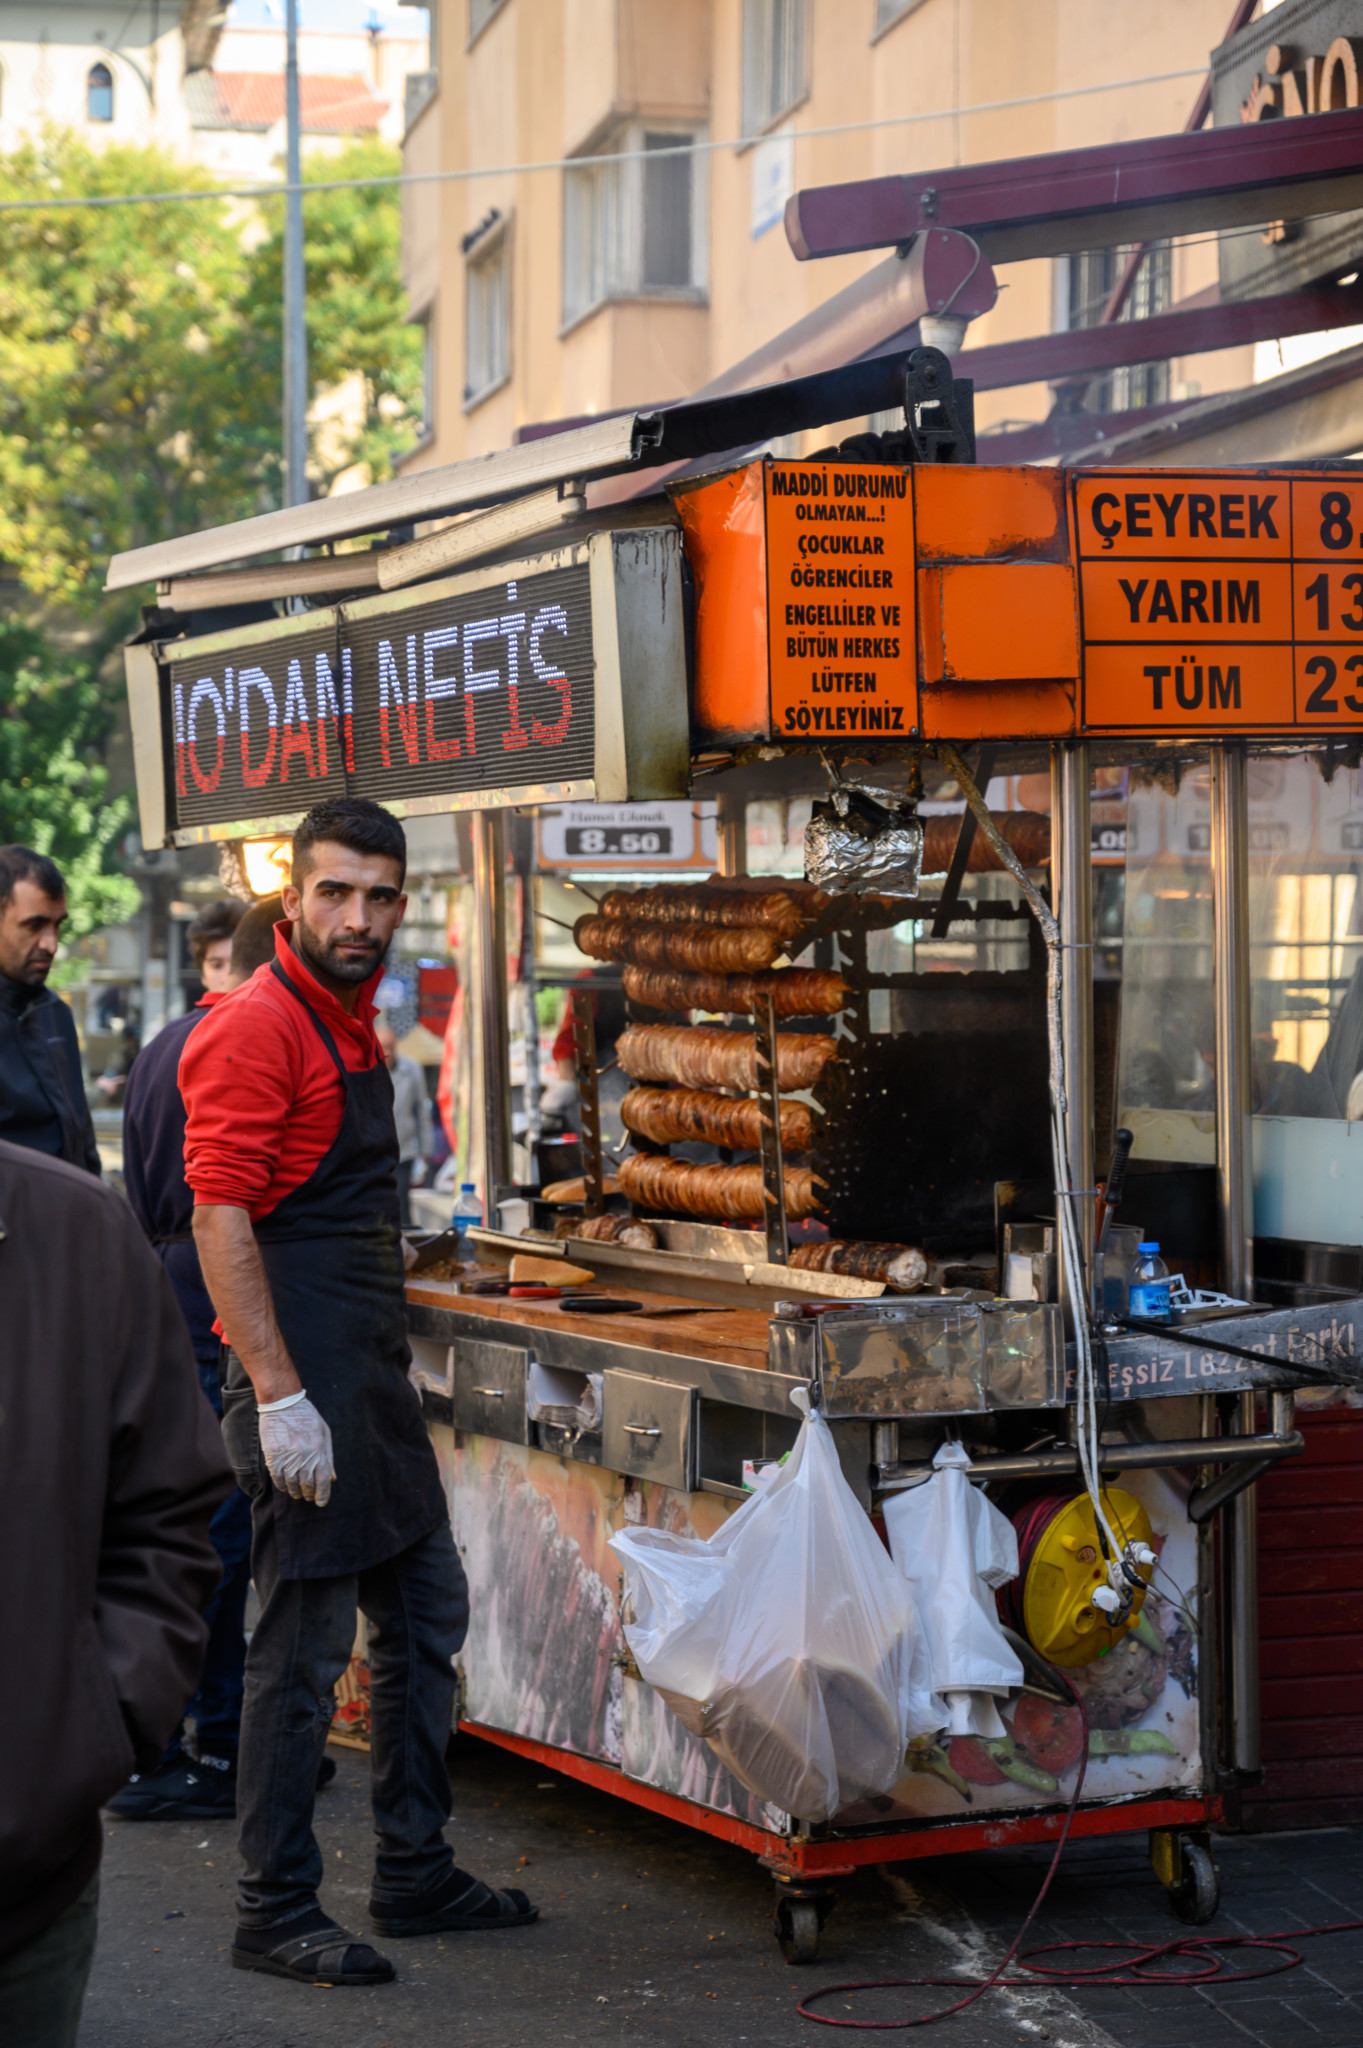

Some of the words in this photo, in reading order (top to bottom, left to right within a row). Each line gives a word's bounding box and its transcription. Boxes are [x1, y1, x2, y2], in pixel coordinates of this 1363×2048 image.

[772, 466, 828, 497] MADDİ
[833, 473, 907, 499] DURUMU
[795, 504, 886, 522] OLMAYAN...!
[1091, 492, 1280, 550] ÇEYREK
[797, 534, 885, 560] ÇOCUKLAR
[790, 562, 893, 589] ÖĞRENCİLER
[785, 598, 876, 627] ENGELLİLER
[881, 605, 901, 626] VE
[1117, 578, 1261, 624] YARIM
[1305, 572, 1363, 632] 13
[786, 630, 838, 658] BÜTÜN
[843, 637, 900, 659] HERKES
[378, 581, 573, 767] NEFİS
[811, 665, 877, 693] LÜTFEN
[1143, 655, 1242, 711] TÜM
[1304, 654, 1363, 714] 23
[784, 699, 905, 731] SÖYLEYİNİZ
[579, 828, 661, 854] 8.50
